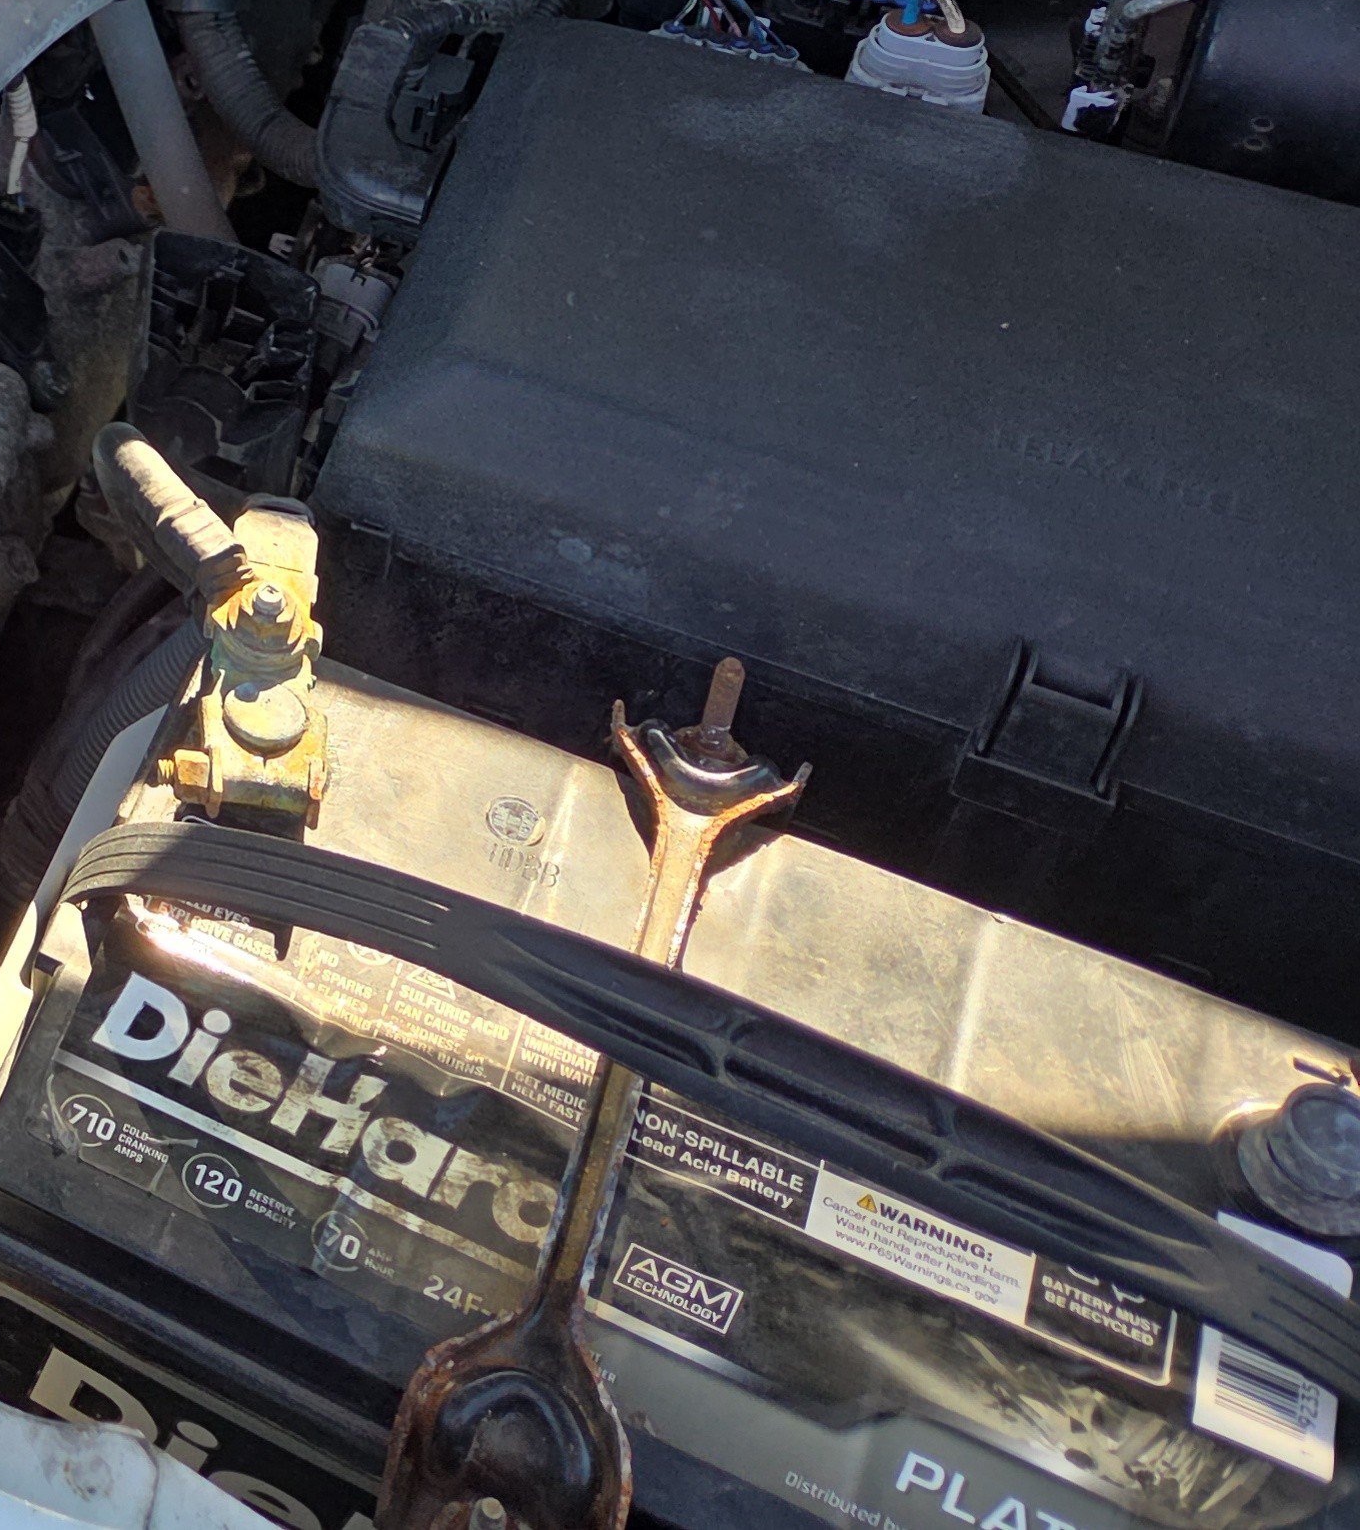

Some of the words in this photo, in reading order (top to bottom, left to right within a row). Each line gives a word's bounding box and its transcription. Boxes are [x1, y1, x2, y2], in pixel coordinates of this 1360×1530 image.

[156, 901, 232, 941] EXPLOSIVE
[232, 931, 279, 963] GASES
[320, 969, 375, 1000] SPARKS
[393, 1000, 422, 1022] CAN
[423, 1012, 469, 1042] CAUSE
[398, 984, 473, 1025] SULFURIC
[471, 1015, 511, 1041] ACID
[514, 1070, 541, 1091] GET
[520, 1047, 557, 1074] WITH
[68, 1102, 117, 1142] 710
[510, 1081, 547, 1105] HELP
[548, 1095, 584, 1124] FAST
[118, 1133, 170, 1163] CRANKING
[122, 1122, 149, 1142] COLD
[633, 1108, 805, 1194] NON-SPILLABLE
[113, 1143, 144, 1165] AMPS
[631, 1128, 676, 1159] Lead
[679, 1151, 722, 1177] Acid
[725, 1168, 794, 1209] Battery
[193, 1163, 243, 1203] 120
[248, 1188, 296, 1218] RESERVE
[244, 1199, 297, 1230] CAPACITY
[879, 1202, 994, 1263] WARNING:
[323, 1220, 361, 1260] 70
[822, 1195, 868, 1222] Cancer
[869, 1217, 894, 1235] and
[897, 1227, 979, 1271] Reproductive
[982, 1263, 1022, 1289] Harm.
[834, 1214, 870, 1238] Wash
[873, 1230, 911, 1256] hands
[913, 1250, 944, 1269] after
[945, 1261, 1002, 1295] handling.
[630, 1257, 733, 1312] AGM
[835, 1228, 999, 1306] www.P65Warnings.ca.gov
[626, 1272, 722, 1323] TECHNOLOGY
[1041, 1274, 1114, 1315] BATTERY
[1114, 1306, 1162, 1336] MUST
[1044, 1290, 1067, 1309] BE
[1068, 1299, 1155, 1347] RECYCLED
[784, 1470, 881, 1528] Distributed
